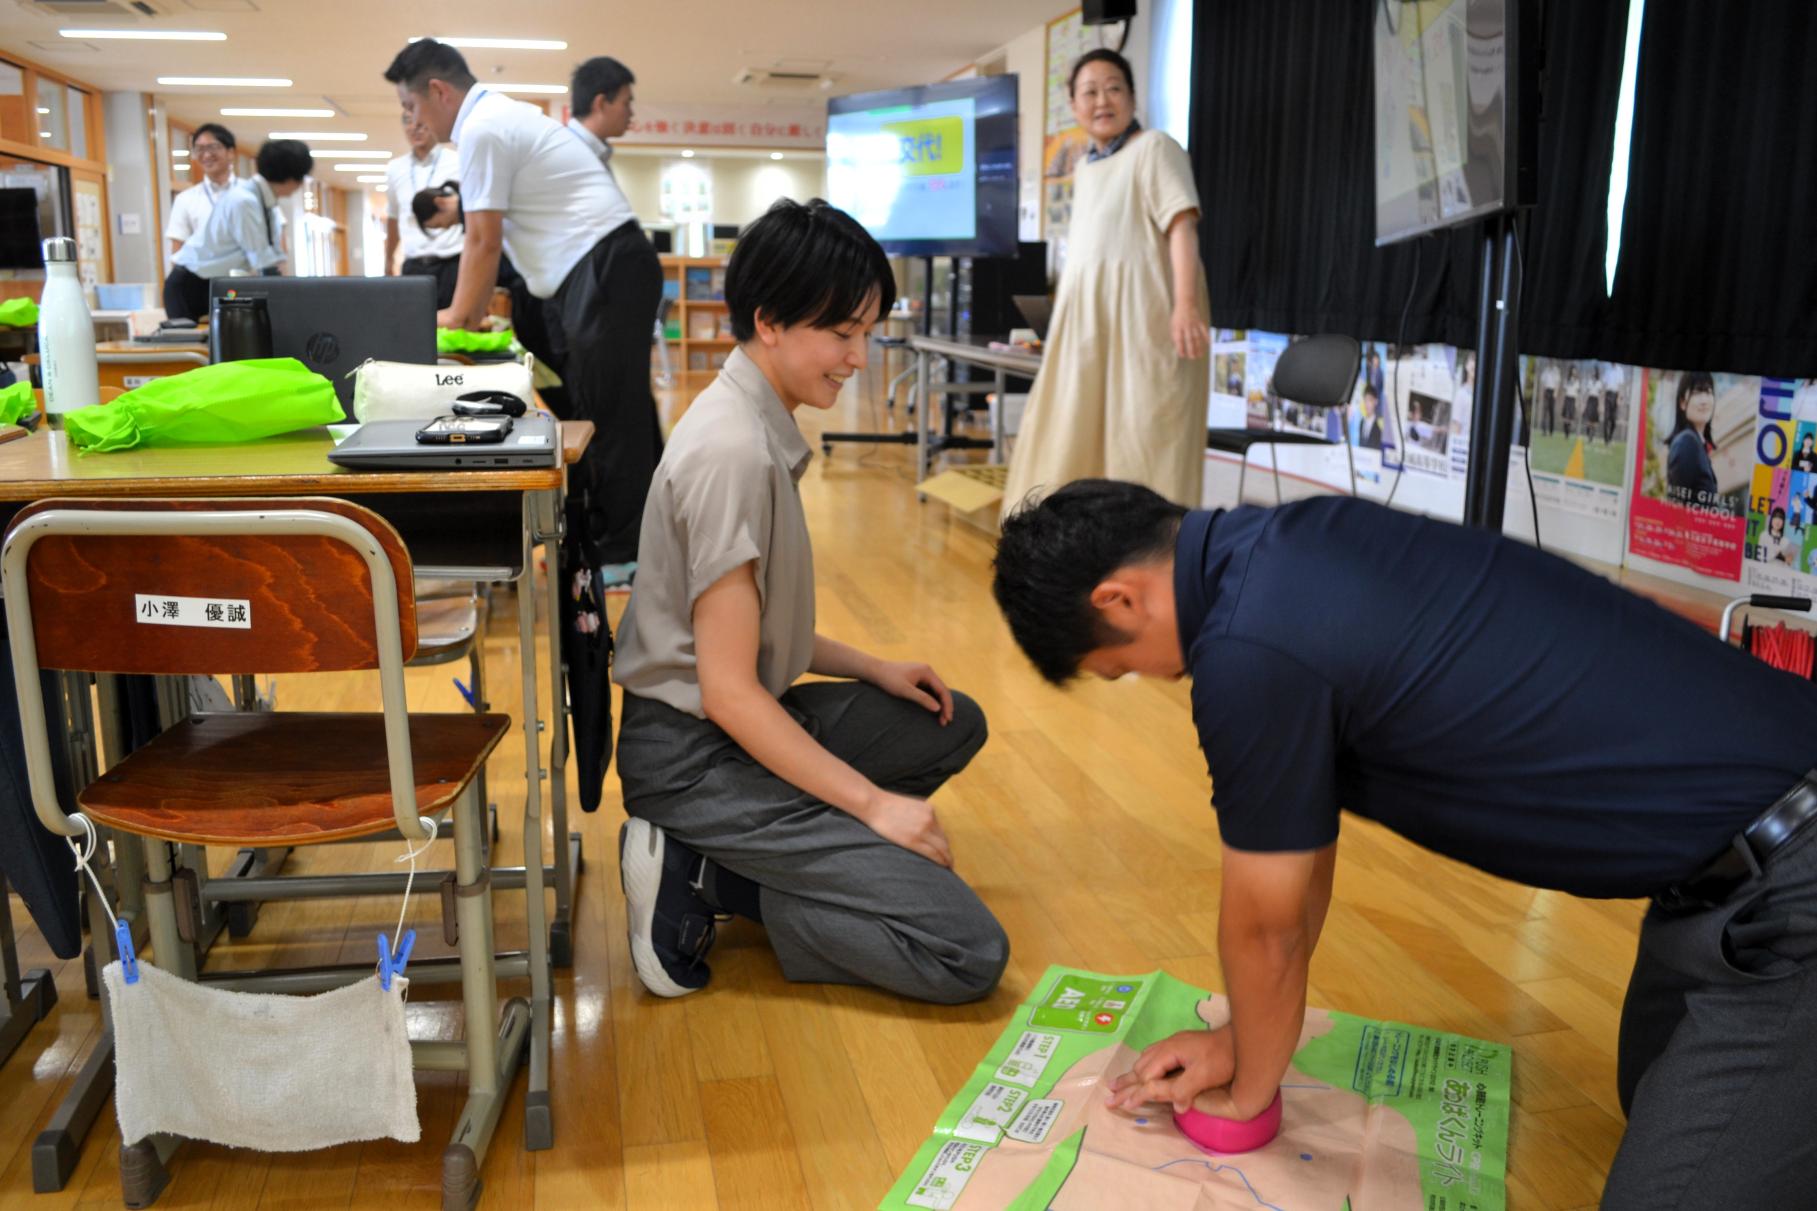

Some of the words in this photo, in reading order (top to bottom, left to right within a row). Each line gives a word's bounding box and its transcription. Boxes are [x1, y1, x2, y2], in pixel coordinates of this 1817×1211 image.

[435, 373, 464, 386] Lee
[1686, 501, 1737, 522] SCHOOL
[1749, 495, 1776, 516] LET
[1746, 517, 1760, 537] IT
[1744, 542, 1768, 564] BE!
[141, 600, 179, 619] 小澤
[205, 603, 247, 622] 優誠
[1052, 986, 1086, 1009] AE
[1432, 1079, 1471, 1185] あっぱくんライト
